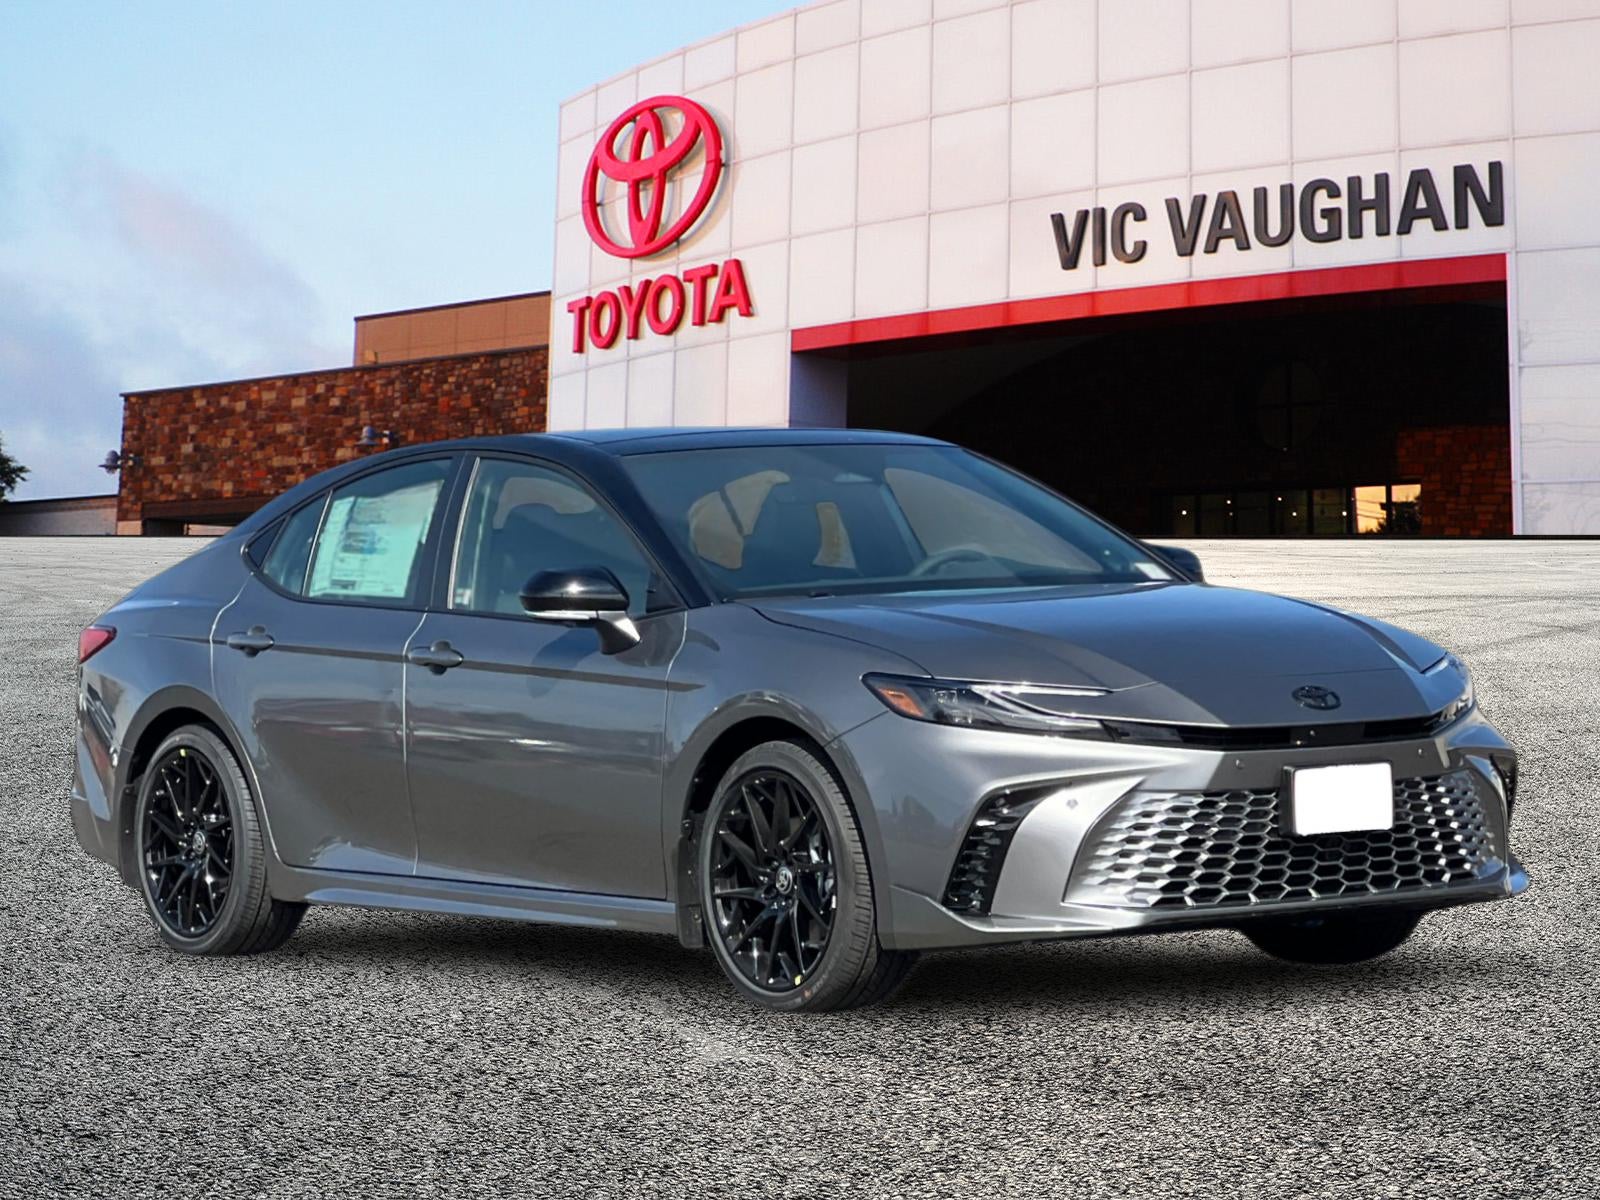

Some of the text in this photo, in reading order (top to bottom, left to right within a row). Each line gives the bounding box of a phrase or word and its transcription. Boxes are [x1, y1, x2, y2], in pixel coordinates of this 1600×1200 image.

[1050, 160, 1506, 271] VIC VAUGHAN
[567, 258, 754, 353] TOYOTA
